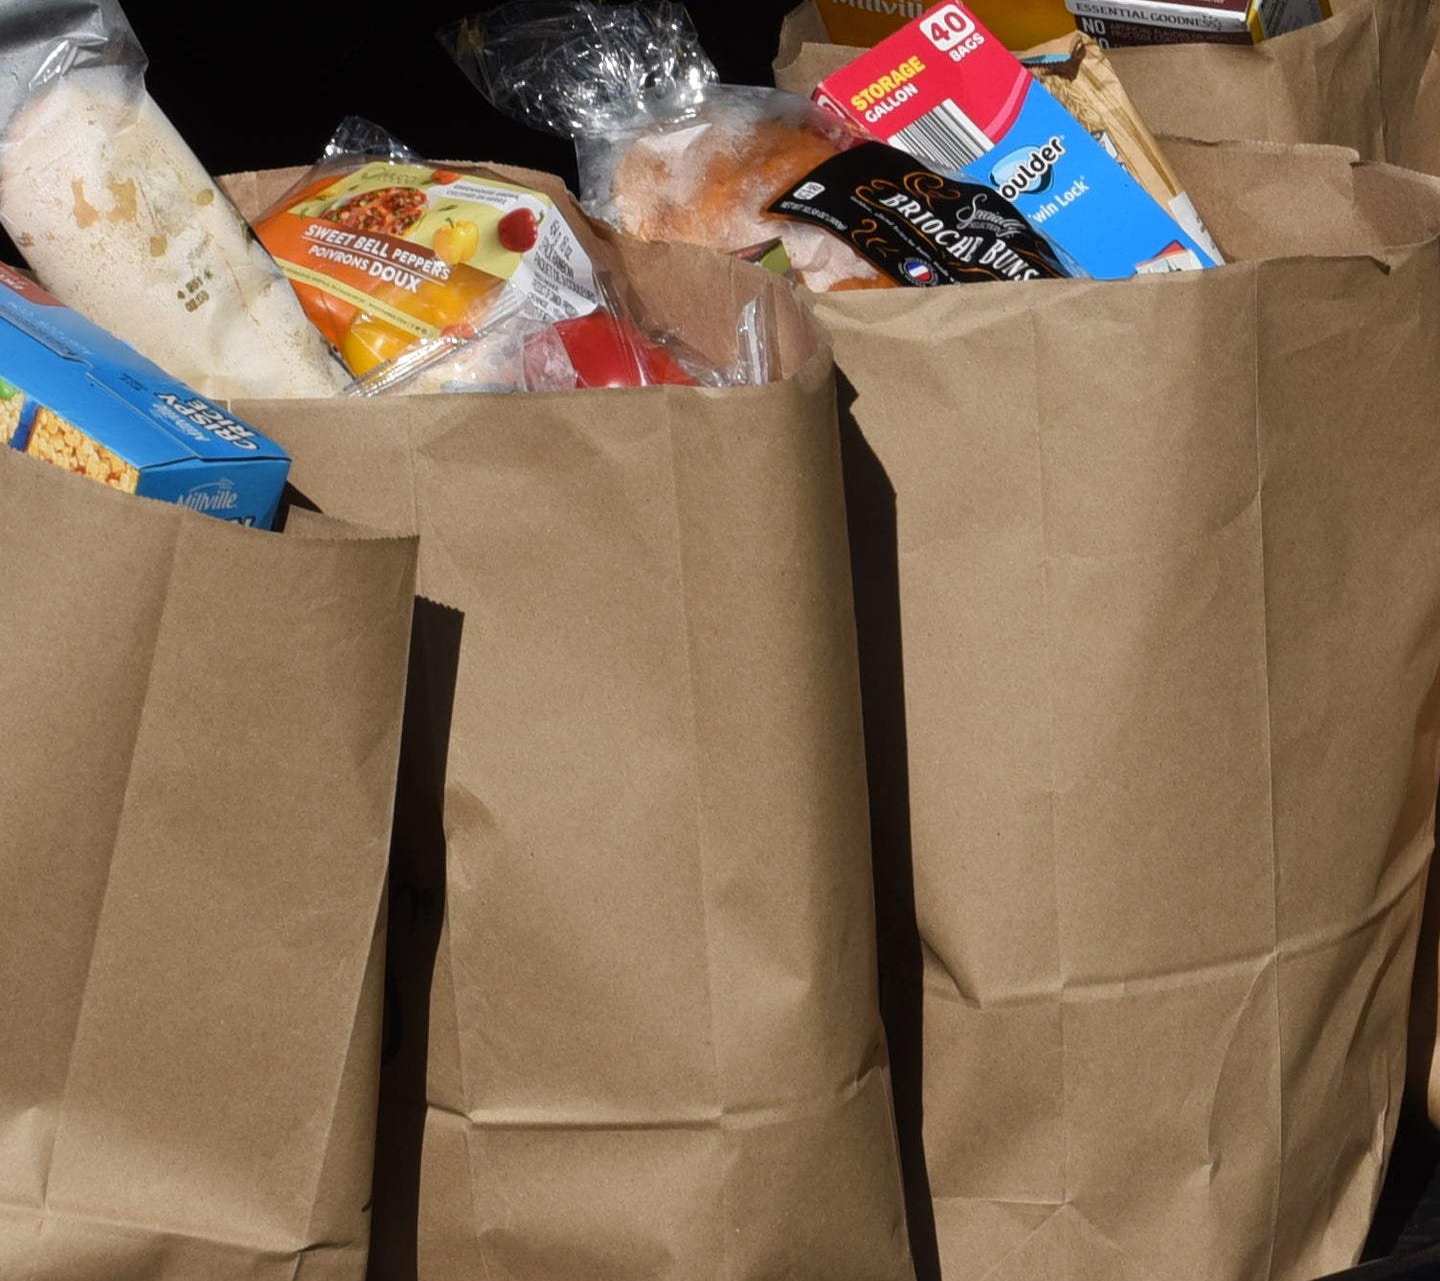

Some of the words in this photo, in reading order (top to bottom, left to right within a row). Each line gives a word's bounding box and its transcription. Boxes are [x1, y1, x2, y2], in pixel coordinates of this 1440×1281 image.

[931, 11, 968, 43] 40
[1076, 1, 1146, 21] ESSENTIAL
[1150, 10, 1220, 29] GOODNESS
[1082, 17, 1106, 35] NO
[948, 32, 986, 63] BAGS
[850, 55, 927, 112] STORAGE
[864, 82, 920, 123] GALLON
[999, 135, 1067, 202] oulder
[1027, 202, 1061, 224] win
[1054, 180, 1090, 208] Lock
[304, 224, 356, 247] SWEET
[353, 236, 389, 259] BELL
[391, 248, 451, 280] PEPPERS
[308, 244, 371, 271] POIVRONS
[368, 261, 424, 294] DOUX
[154, 391, 260, 450] CRISPY
[183, 397, 259, 438] RICE
